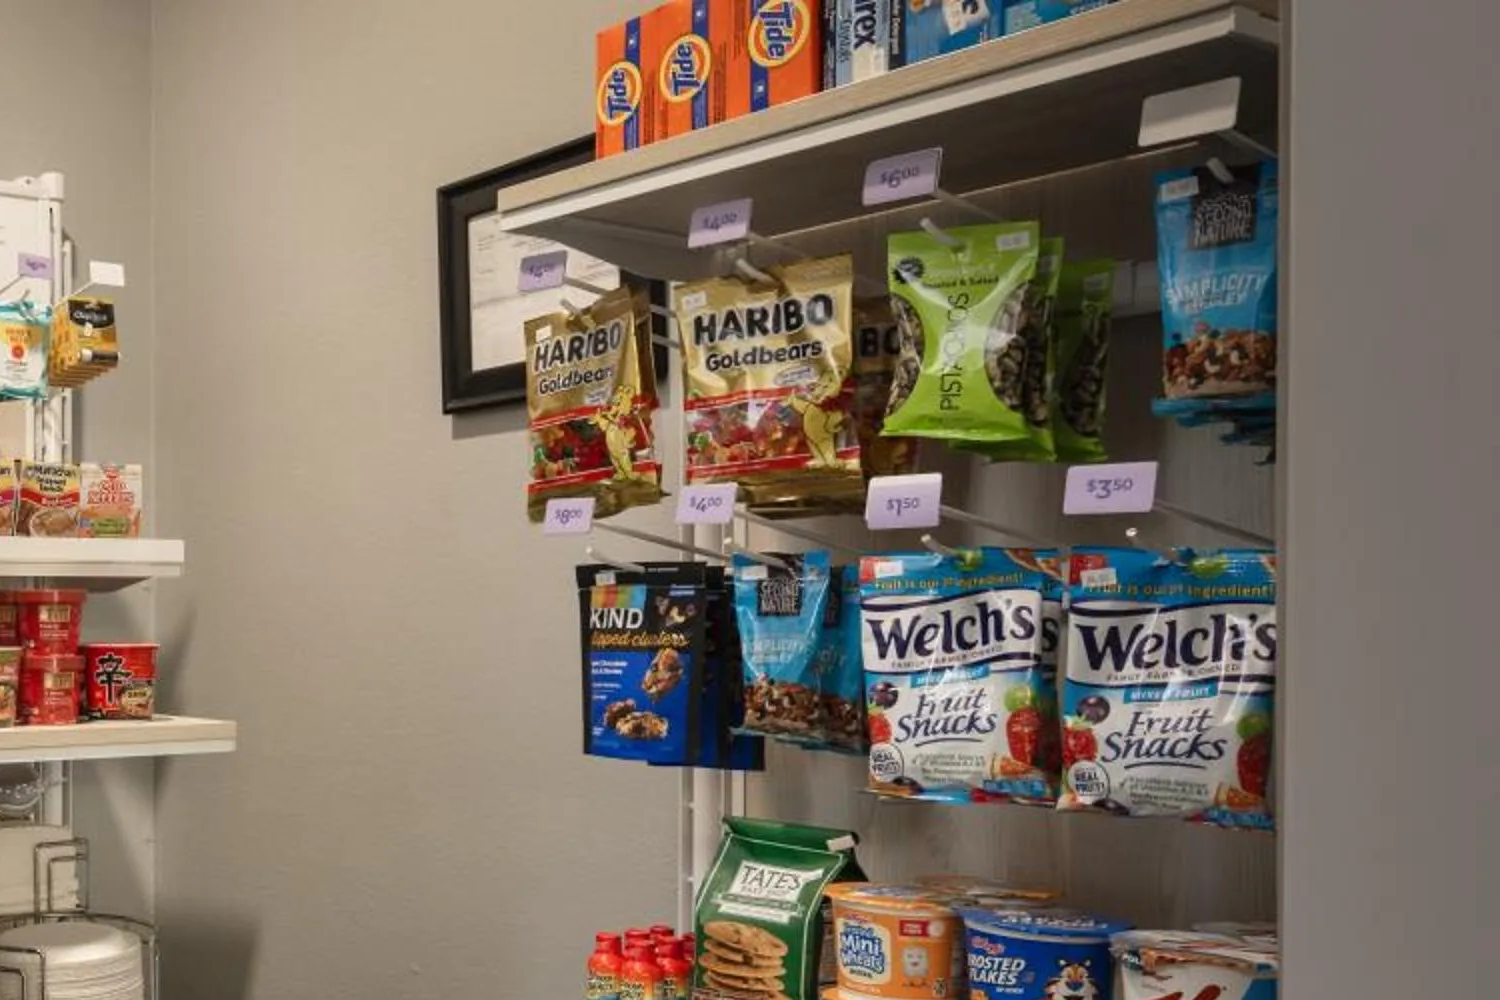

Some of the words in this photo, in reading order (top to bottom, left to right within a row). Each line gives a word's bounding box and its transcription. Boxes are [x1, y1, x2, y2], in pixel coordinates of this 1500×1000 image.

[760, 1, 792, 59] Tide
[671, 43, 700, 96] Tide
[608, 69, 631, 118] Tide
[694, 293, 835, 346] HARIBO
[533, 320, 623, 373] HARIBO
[705, 340, 822, 372] Goldbears
[589, 608, 644, 629] KIND
[866, 597, 1037, 661] Welch's
[1075, 613, 1277, 673] Welch's
[916, 685, 987, 719] Fruit
[894, 710, 998, 744] Snacks
[1127, 708, 1215, 737] Fruit
[1101, 730, 1229, 761] Snacks
[841, 932, 881, 955] Mini
[968, 953, 1026, 971] ROSTED
